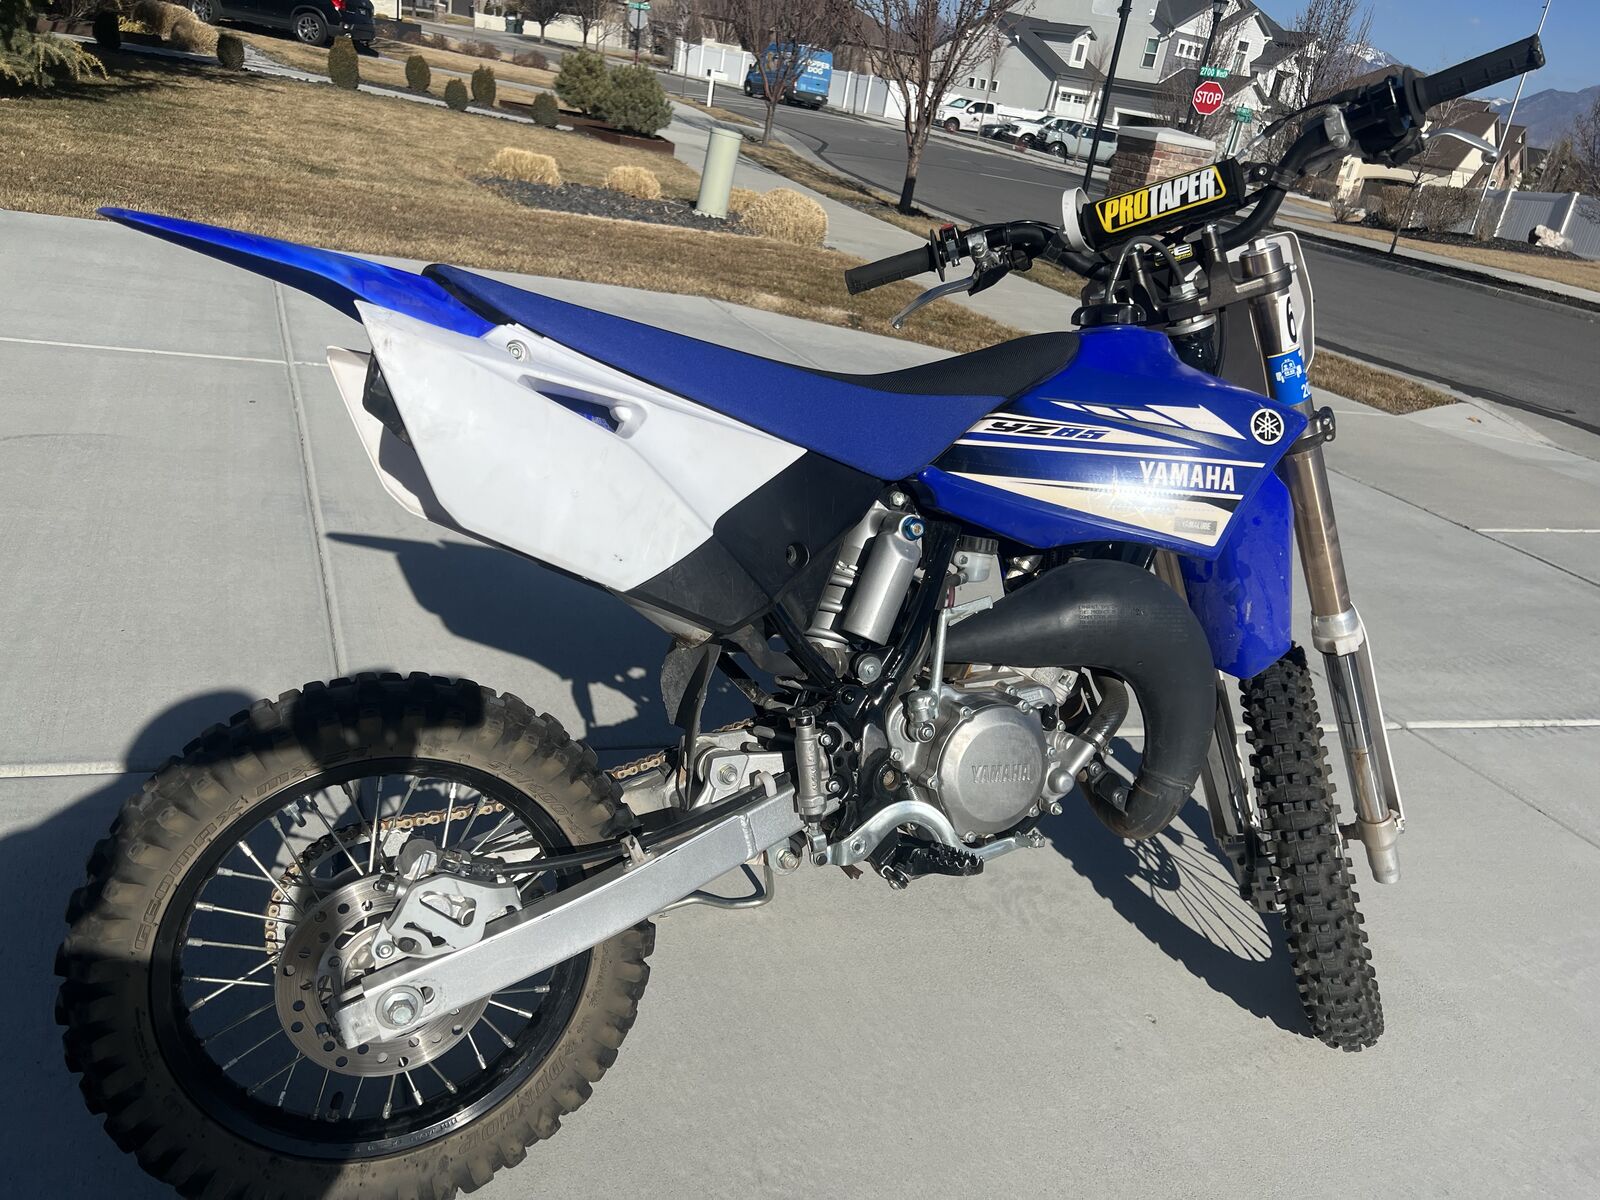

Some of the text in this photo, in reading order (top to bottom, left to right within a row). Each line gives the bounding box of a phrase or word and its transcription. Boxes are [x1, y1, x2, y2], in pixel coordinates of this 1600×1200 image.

[1200, 67, 1215, 76] 2700
[1195, 90, 1222, 105] STOP
[1103, 168, 1217, 233] PROTAPER
[1140, 460, 1235, 491] YAMAHA
[971, 763, 1032, 784] YAMAHA
